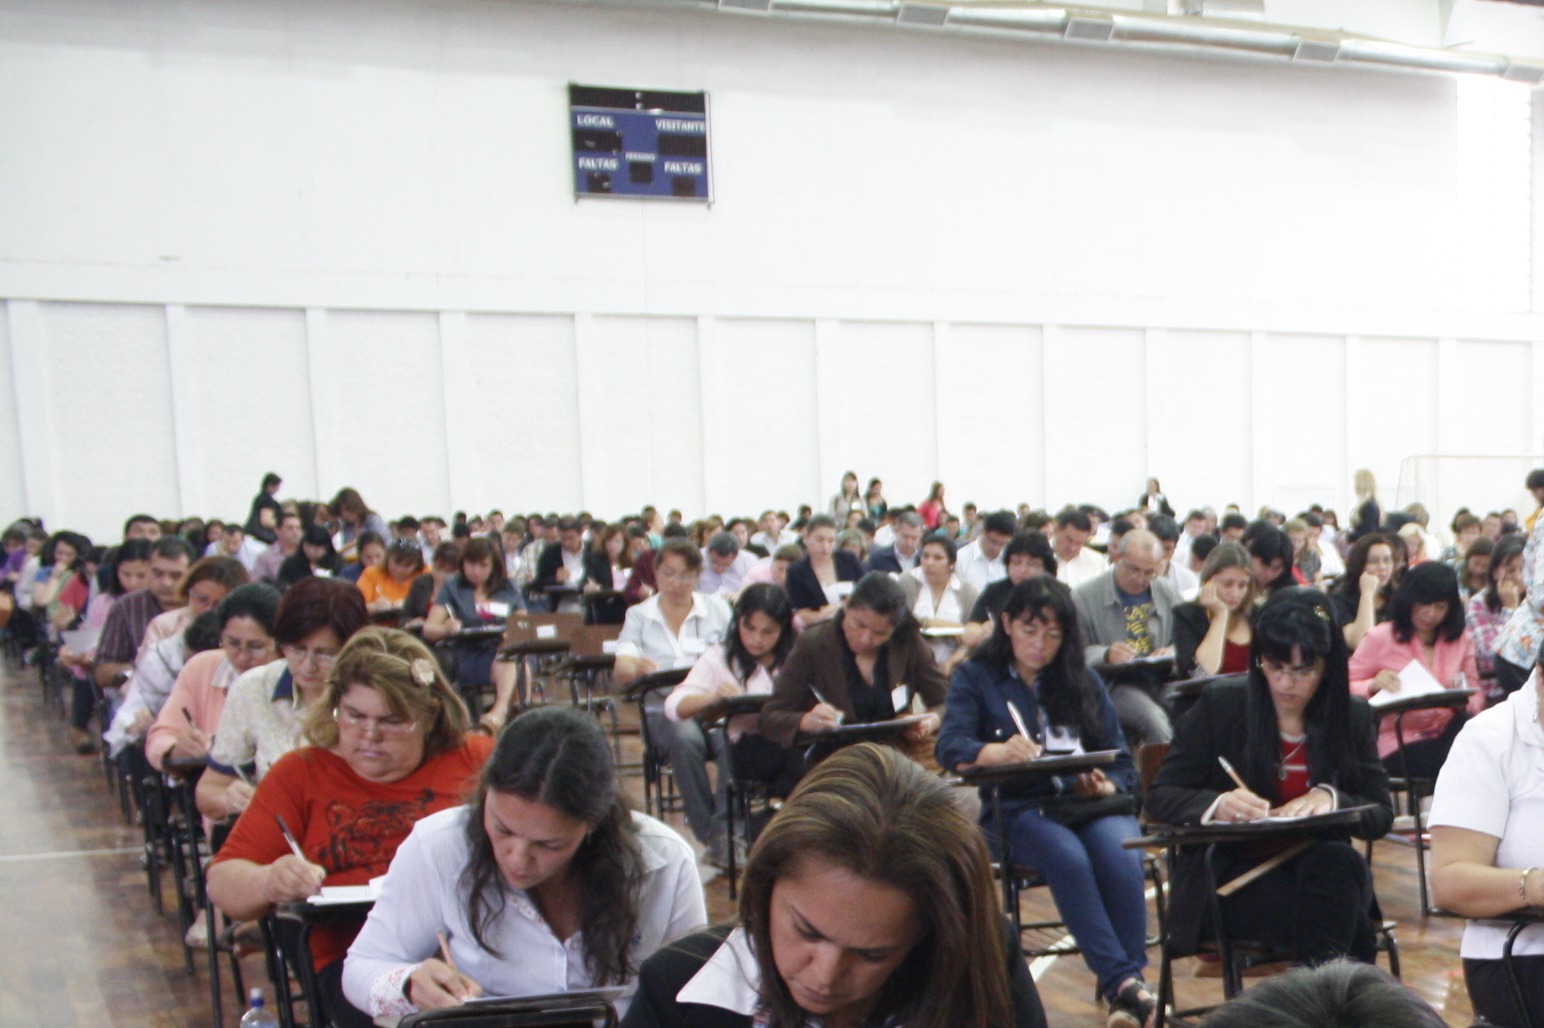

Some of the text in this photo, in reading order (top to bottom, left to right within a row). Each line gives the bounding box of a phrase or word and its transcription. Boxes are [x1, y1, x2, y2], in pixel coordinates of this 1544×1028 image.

[577, 115, 614, 128] LOCAL
[578, 157, 617, 170] FALTAS
[664, 161, 701, 173] FALTAS
